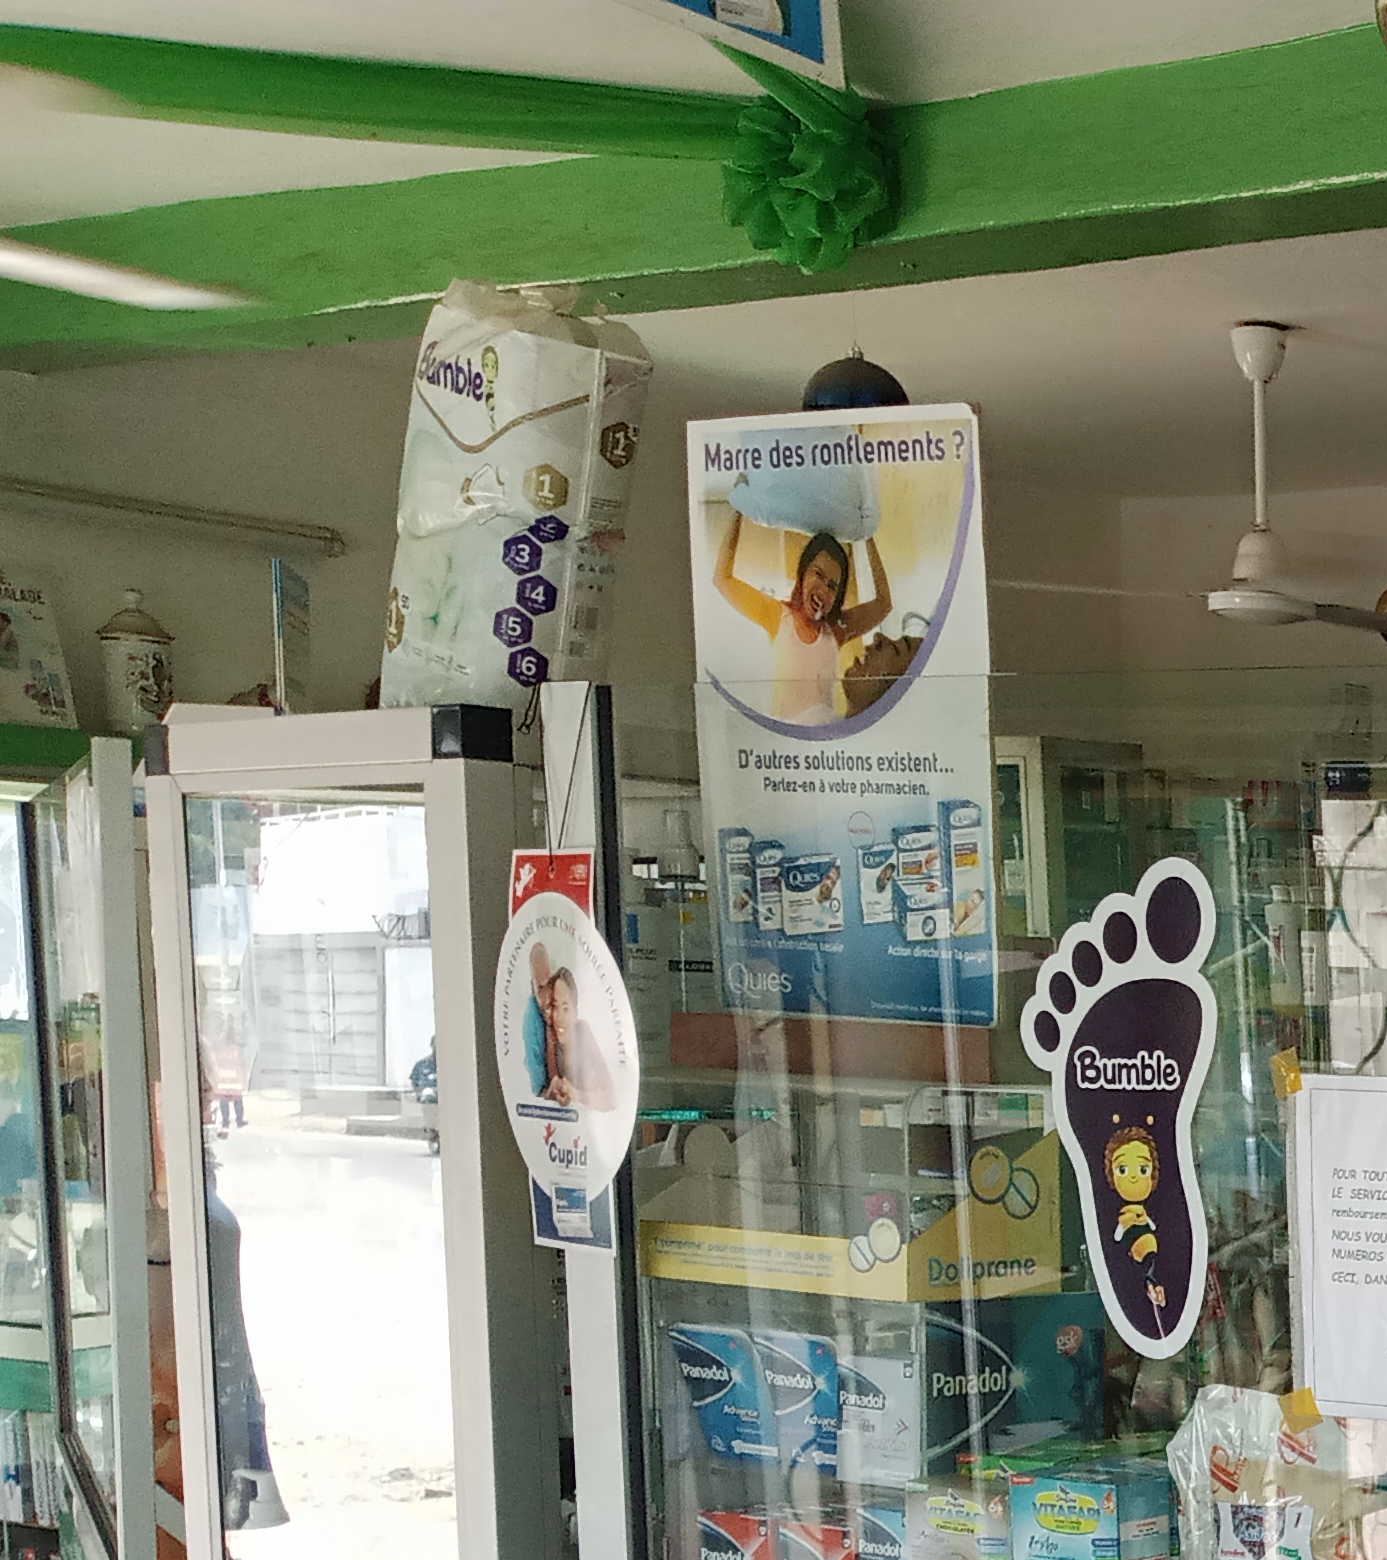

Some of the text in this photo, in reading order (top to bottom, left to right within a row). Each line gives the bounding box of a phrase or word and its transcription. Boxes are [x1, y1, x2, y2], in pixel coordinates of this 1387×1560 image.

[704, 430, 965, 473] Marre des ronflements ?
[532, 585, 545, 603] 4
[508, 617, 522, 636] 5
[523, 656, 536, 676] 6
[738, 749, 800, 770] D'autres
[805, 751, 873, 772] solutions
[764, 777, 816, 793] Parlez-en
[829, 780, 856, 794] votre
[860, 779, 930, 797] pharmacien.
[727, 962, 792, 998] Quies
[1075, 1046, 1181, 1090] Bumble
[548, 1141, 588, 1169] Cupid
[1332, 1168, 1357, 1180] POUR
[1332, 1187, 1344, 1199] LE
[1332, 1230, 1362, 1242] NOUS
[1332, 1248, 1385, 1262] NUMEROS
[1056, 1331, 1078, 1353] gsk
[681, 1362, 731, 1382] Panadol
[765, 1370, 815, 1390] Panadol
[933, 1366, 1007, 1397] Panadol
[839, 1390, 884, 1409] Panadol
[859, 1539, 901, 1558] Panadol
